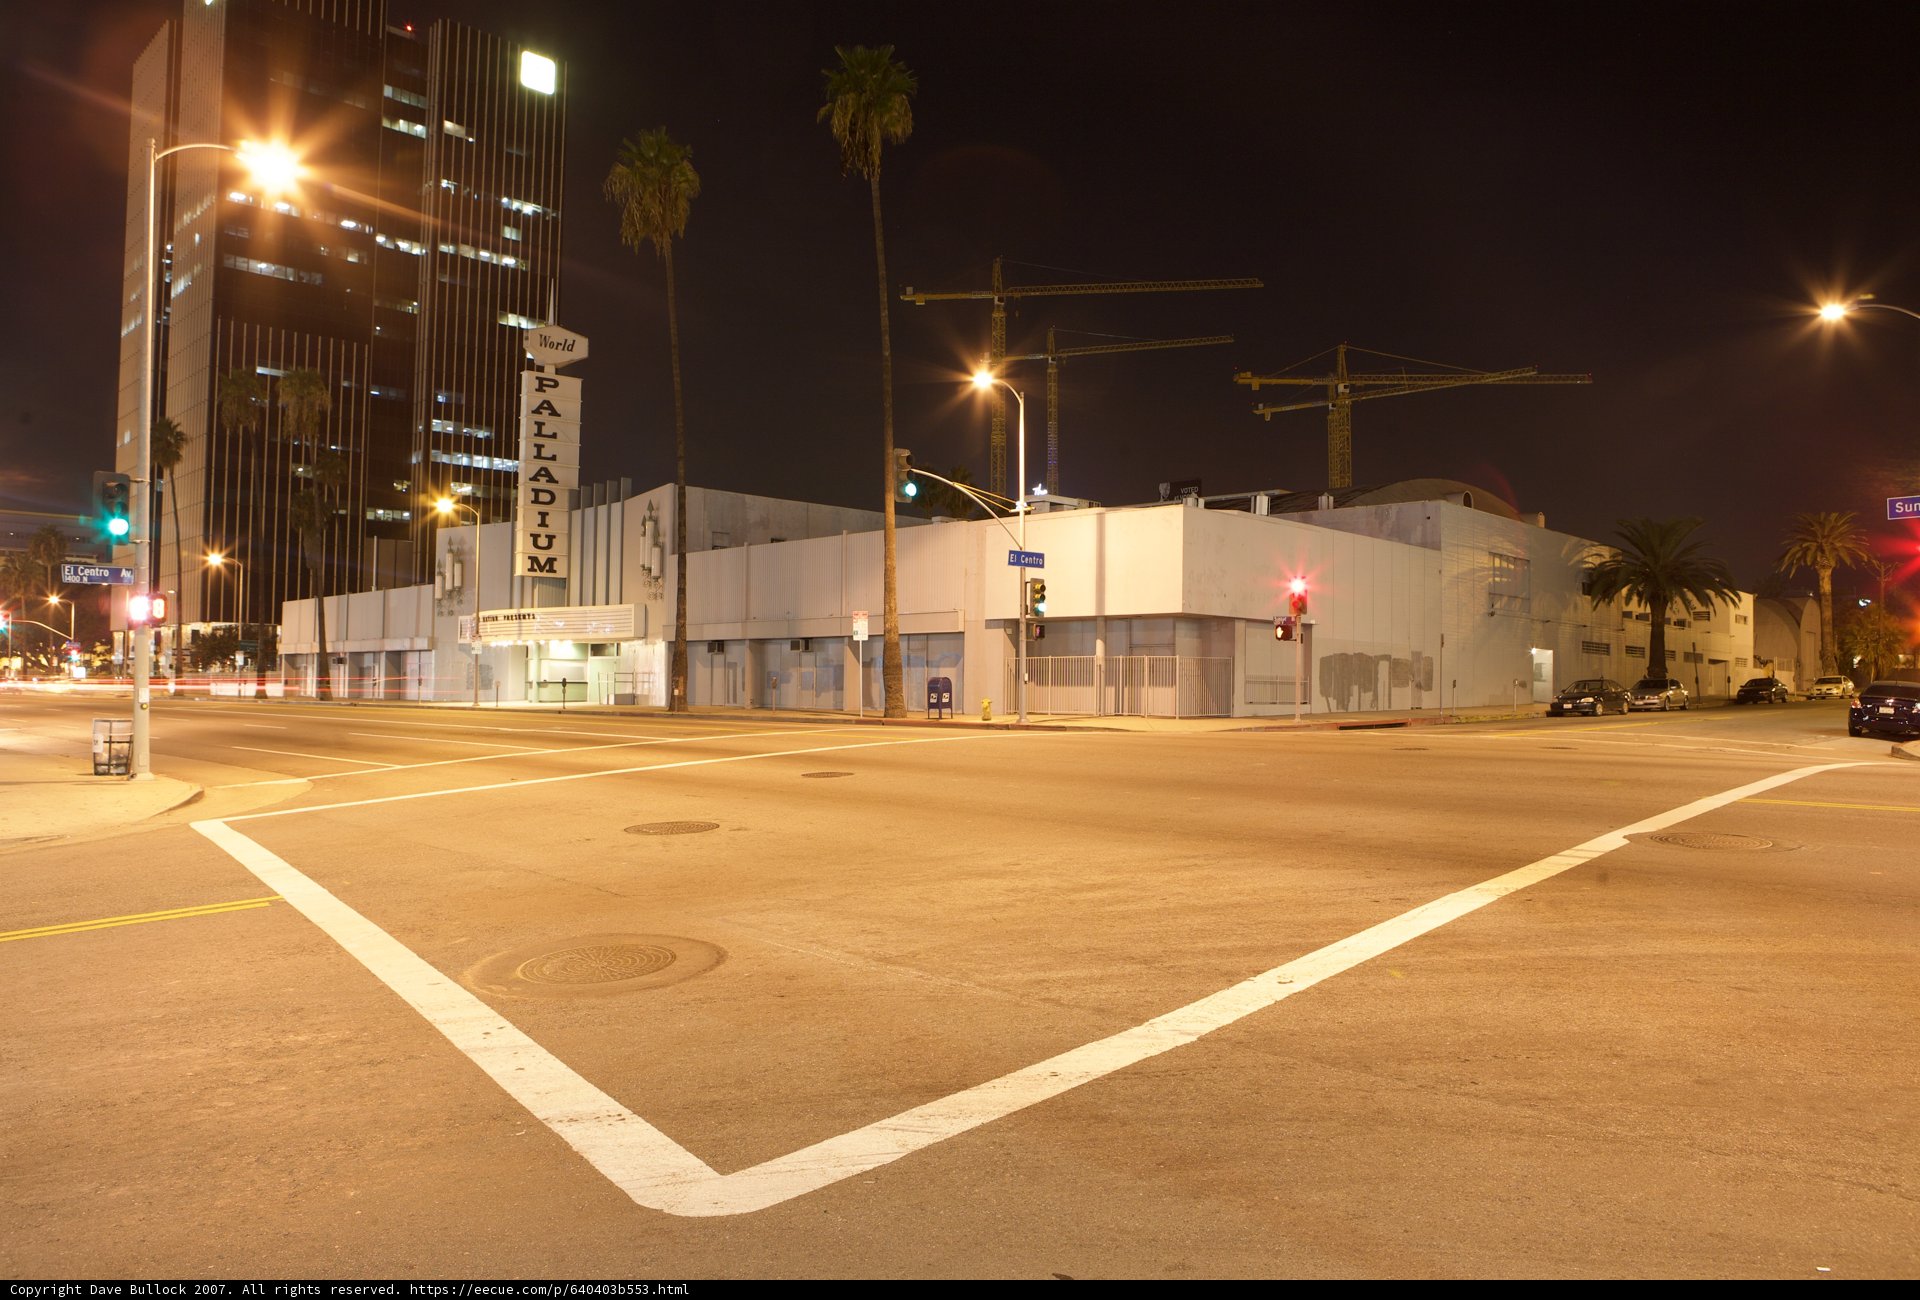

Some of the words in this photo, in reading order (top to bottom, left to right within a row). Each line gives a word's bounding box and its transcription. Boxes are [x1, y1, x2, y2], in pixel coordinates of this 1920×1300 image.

[538, 334, 576, 352] World
[527, 375, 562, 574] PALLADIUM
[1895, 501, 1920, 513] Sun
[1010, 553, 1017, 563] El
[1020, 554, 1044, 565] Centro
[64, 565, 74, 576] El
[77, 566, 109, 577] Centro
[65, 575, 81, 583] 1400
[503, 613, 536, 622] PRESENTS
